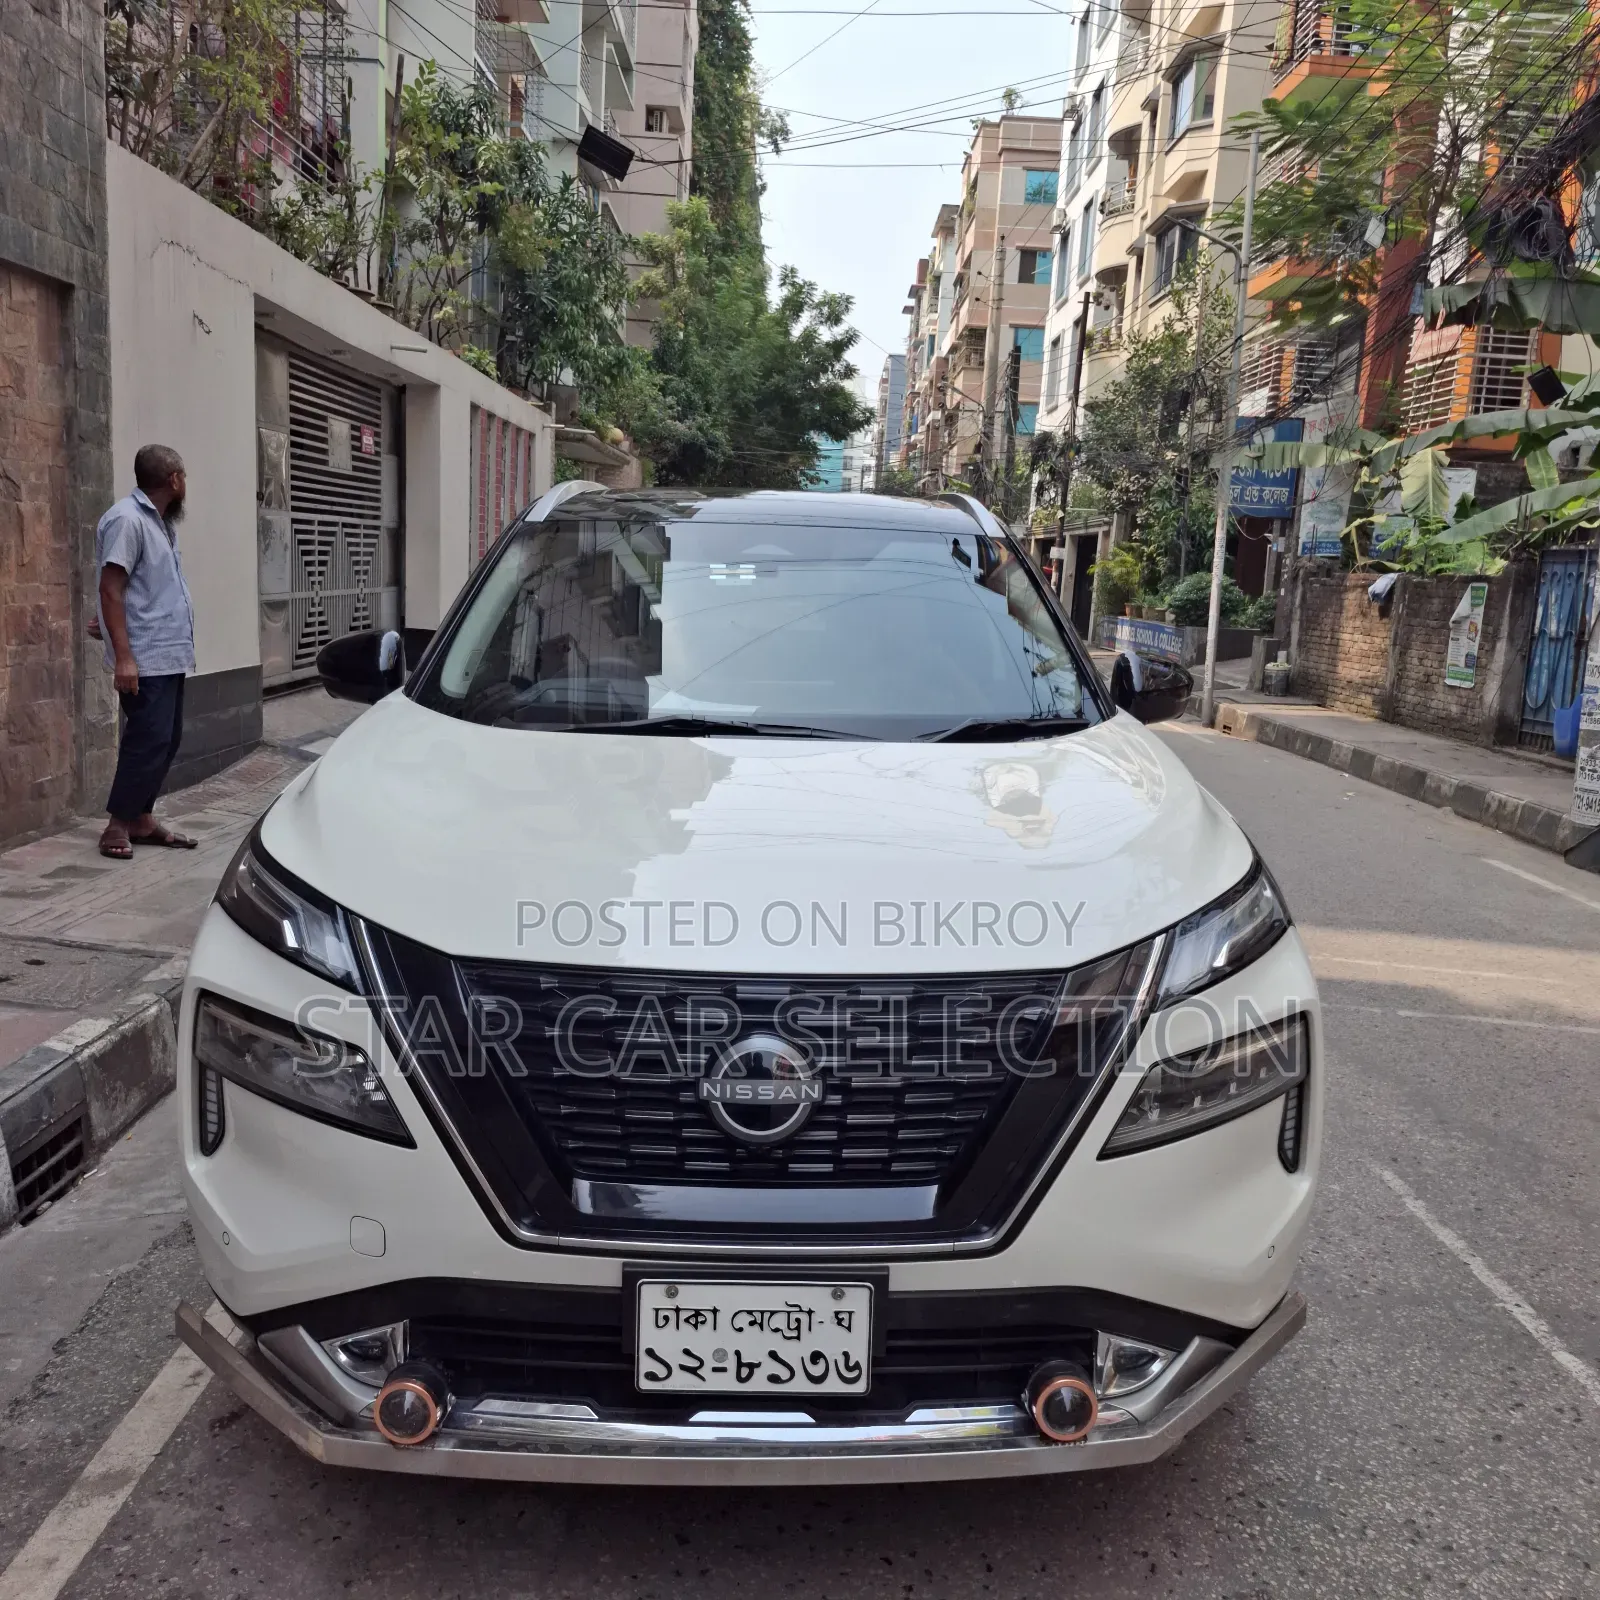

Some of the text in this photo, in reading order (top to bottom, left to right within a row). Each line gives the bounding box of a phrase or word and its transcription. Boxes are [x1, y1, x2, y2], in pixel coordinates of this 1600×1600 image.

[1244, 486, 1260, 503] এন্ড
[1261, 487, 1290, 504] কলেজ
[1136, 628, 1153, 646] SCHOOL
[1154, 632, 1159, 645] &
[1159, 632, 1183, 654] COLLEGE
[703, 1083, 819, 1100] NISSAN
[653, 1305, 720, 1331] ঢাকা
[643, 1347, 863, 1385] ১২-৮১৩৬
